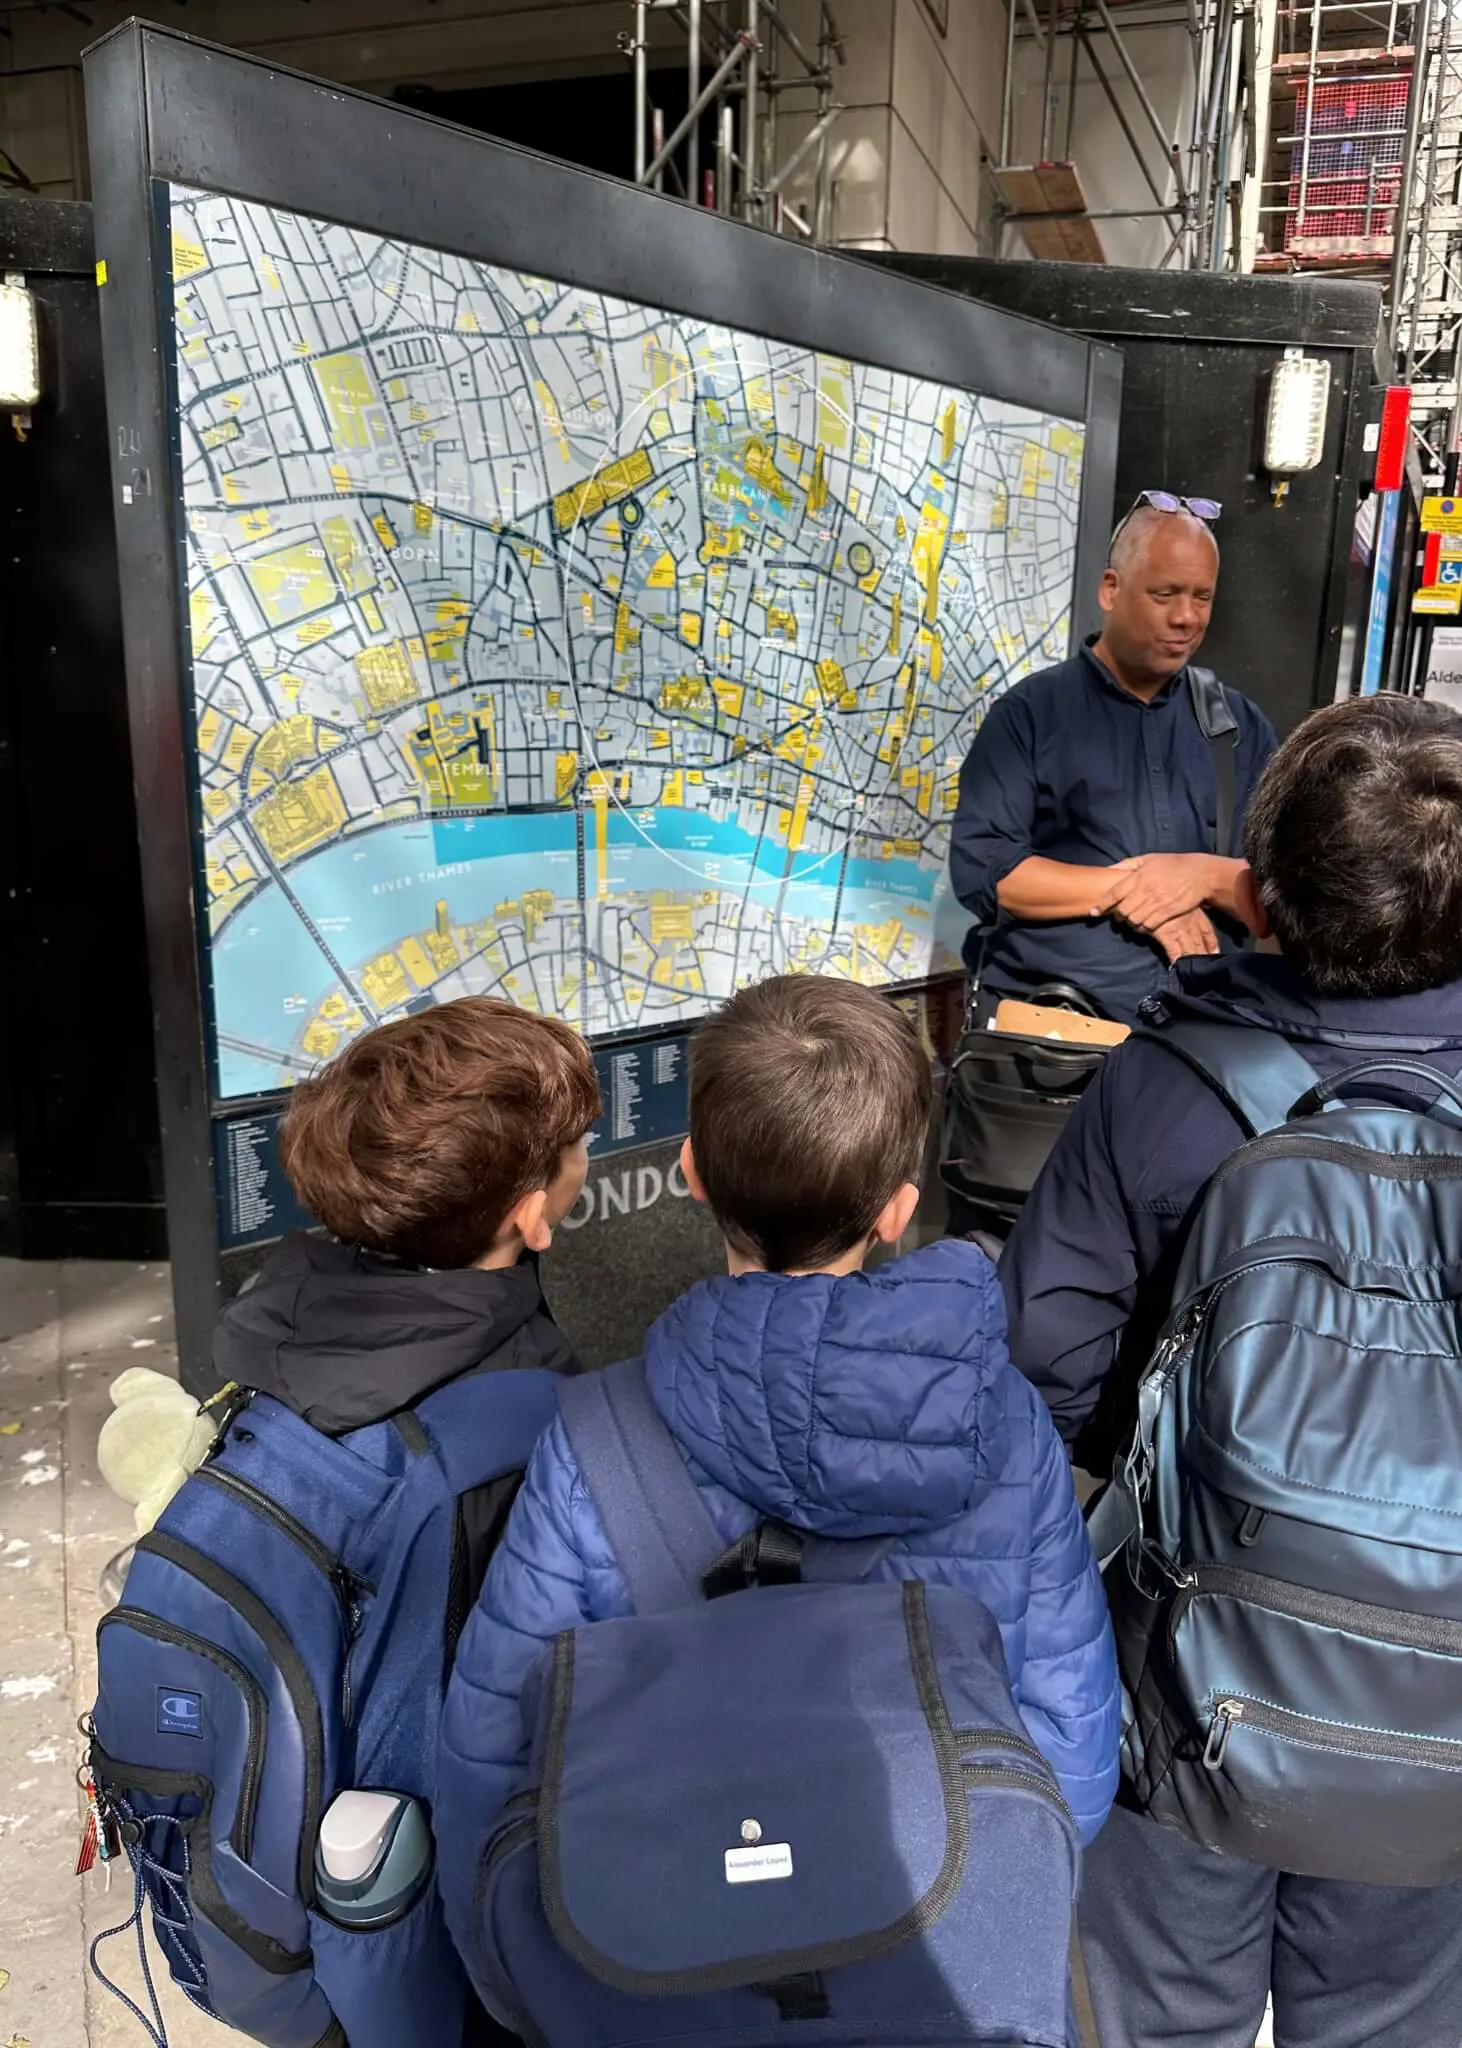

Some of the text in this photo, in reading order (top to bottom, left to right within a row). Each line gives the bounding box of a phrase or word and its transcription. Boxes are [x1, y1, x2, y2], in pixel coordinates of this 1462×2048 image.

[440, 762, 505, 777] TEMPLE
[372, 861, 472, 895] RIVER THAMES
[561, 1160, 691, 1229] ONDO
[728, 1858, 765, 1869] Alexander
